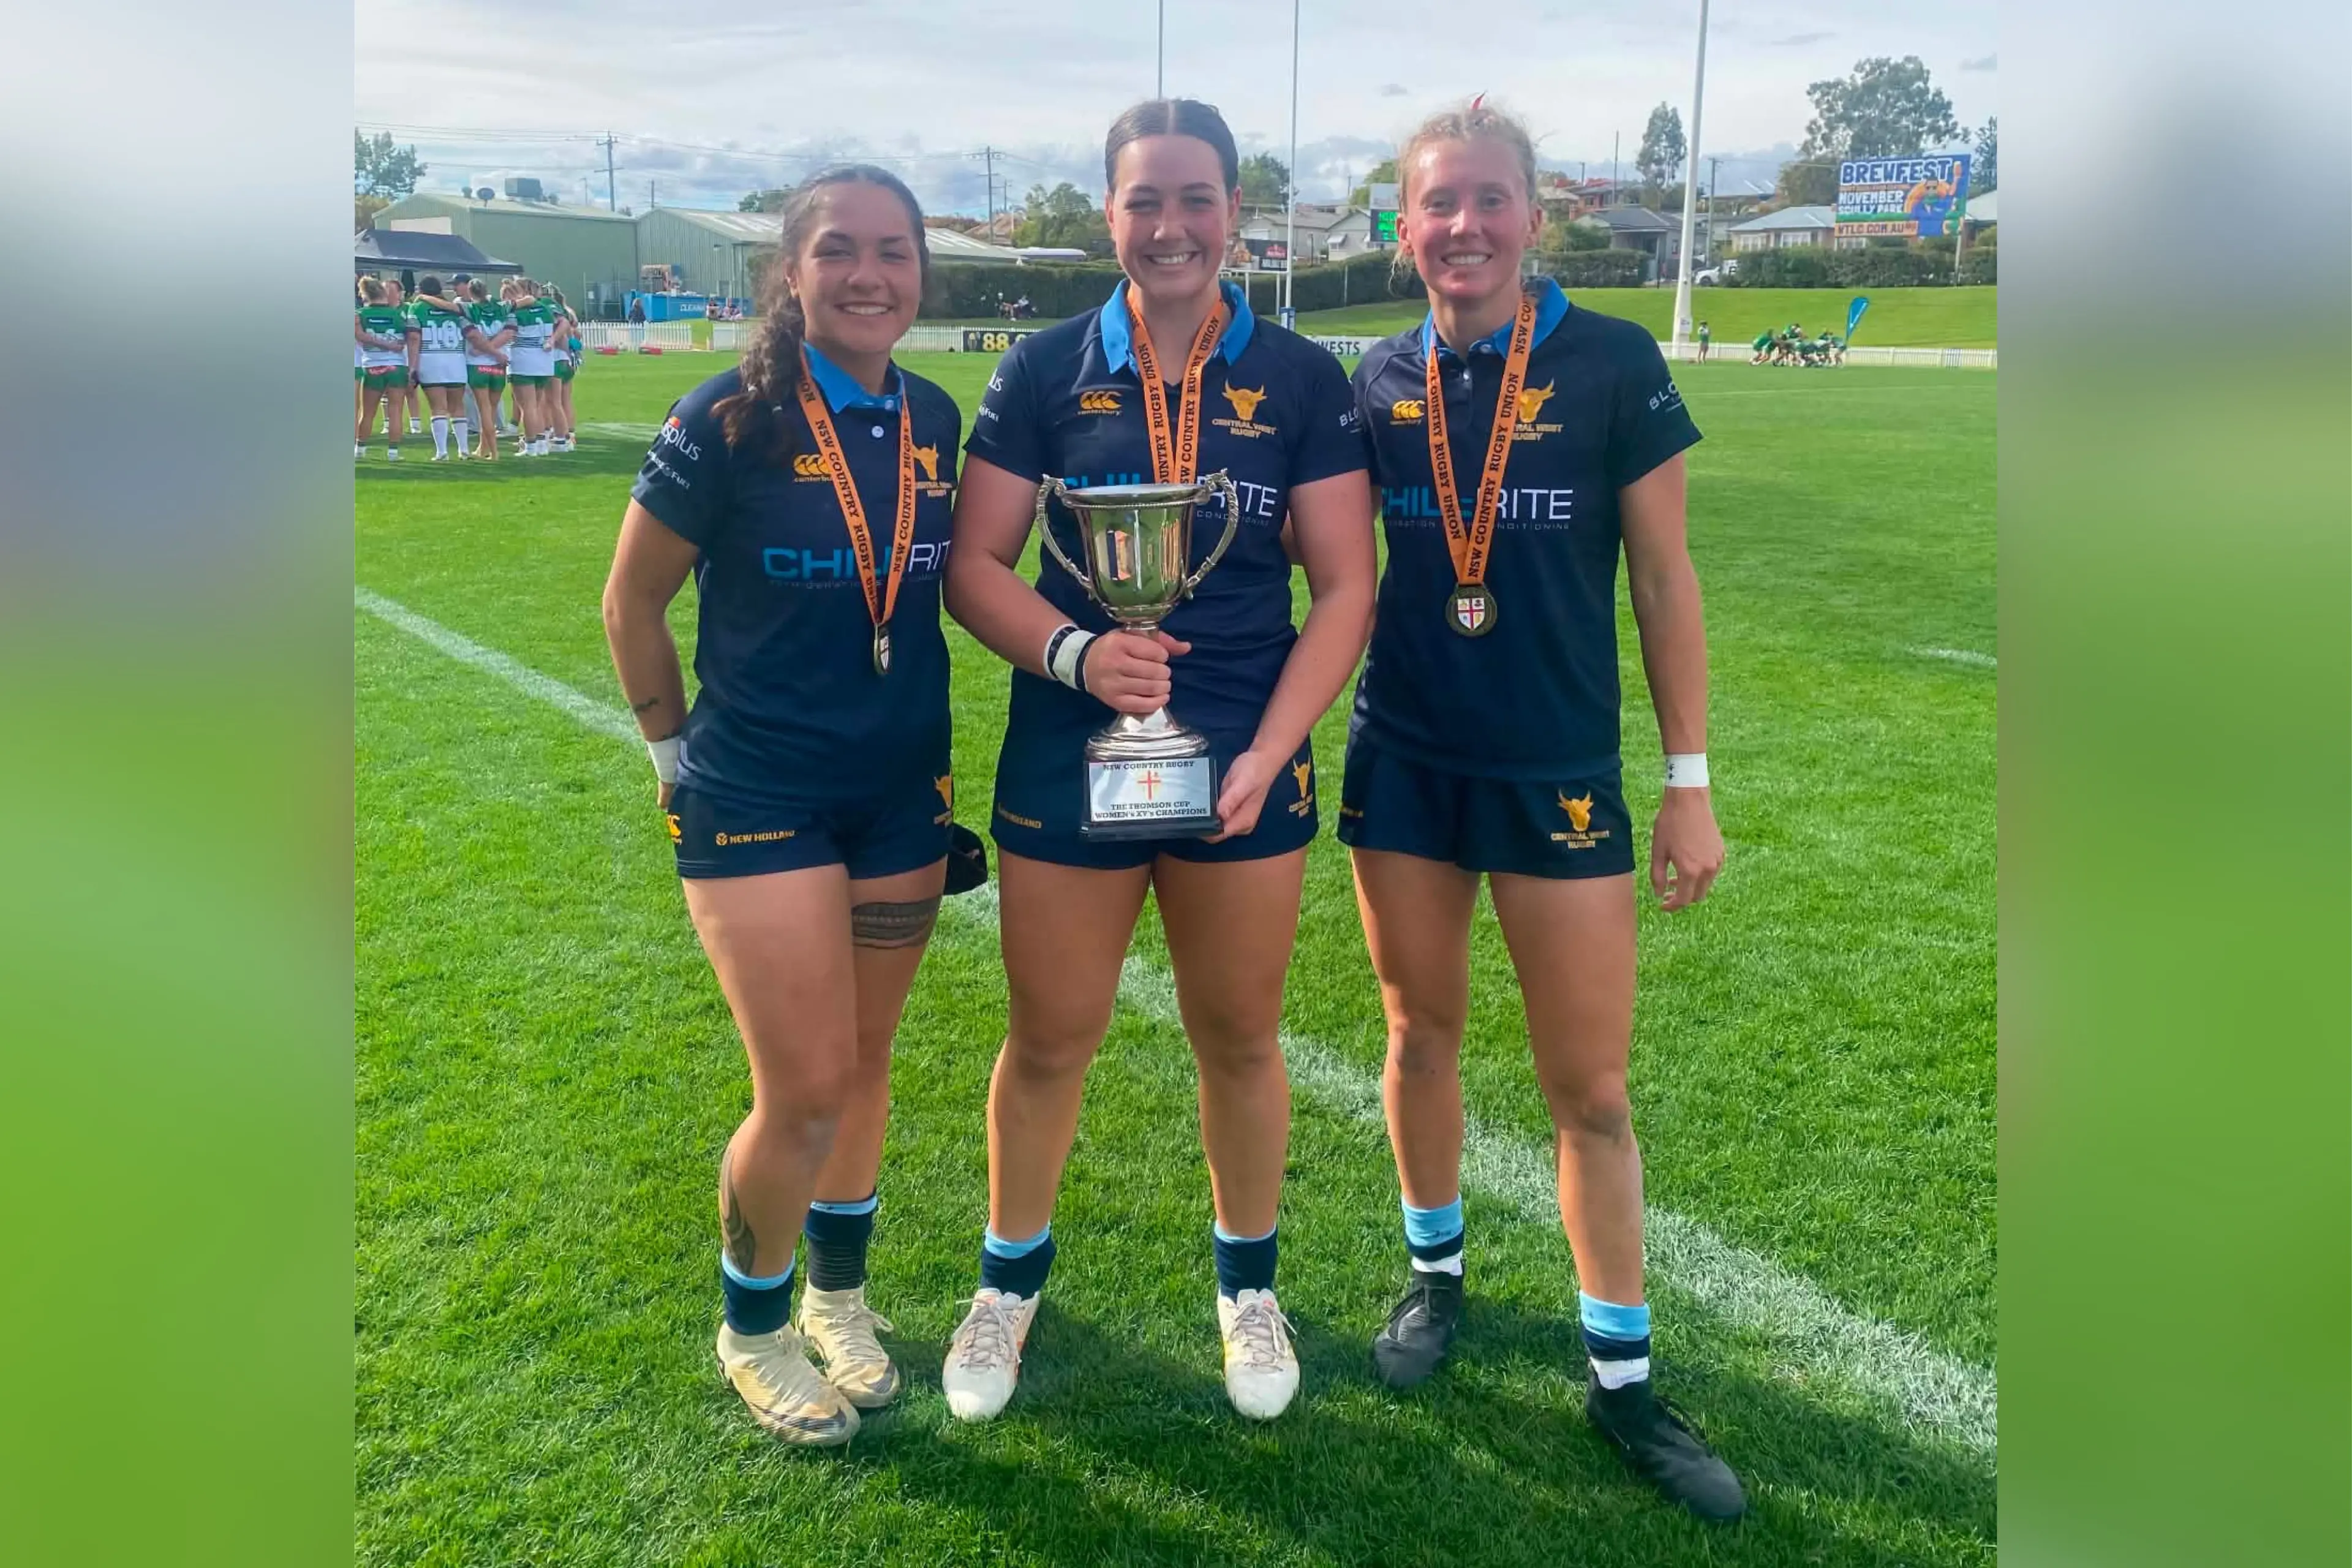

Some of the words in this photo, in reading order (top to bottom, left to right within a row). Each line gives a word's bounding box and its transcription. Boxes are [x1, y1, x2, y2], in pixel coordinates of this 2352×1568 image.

[1841, 158, 1953, 186] BREWFEST
[1838, 203, 1875, 214] SCULLY
[1877, 203, 1903, 214] PARK
[1839, 190, 1904, 205] NOVEMBER
[1199, 315, 1219, 351] UNION
[1514, 324, 1528, 355] NSW
[1138, 342, 1156, 380] UNION
[1187, 354, 1203, 393] RUGBY
[1149, 383, 1164, 428] RUGBY
[1501, 373, 1519, 418] UNION
[1182, 399, 1195, 462] COUNTRY
[1489, 424, 1508, 472] RUGBY
[1155, 434, 1170, 484] OUNTRY
[815, 420, 834, 447] NSW
[829, 452, 860, 518] COUNTRY
[853, 524, 871, 571] RUGBY
[1434, 442, 1450, 489] RUGBY
[1443, 494, 1461, 540] UNION
[893, 543, 906, 572] NSW
[900, 475, 912, 540] COUNTRY
[1475, 477, 1496, 545] COUNTRY
[1468, 547, 1483, 578] NSW
[1123, 761, 1164, 770] COUNTRY
[1165, 760, 1196, 769] RUGBY
[1129, 801, 1171, 810] THOMSON
[1155, 807, 1207, 816] CHAMPIONS
[729, 834, 752, 845] NEW
[753, 830, 795, 842] HOLLAND
